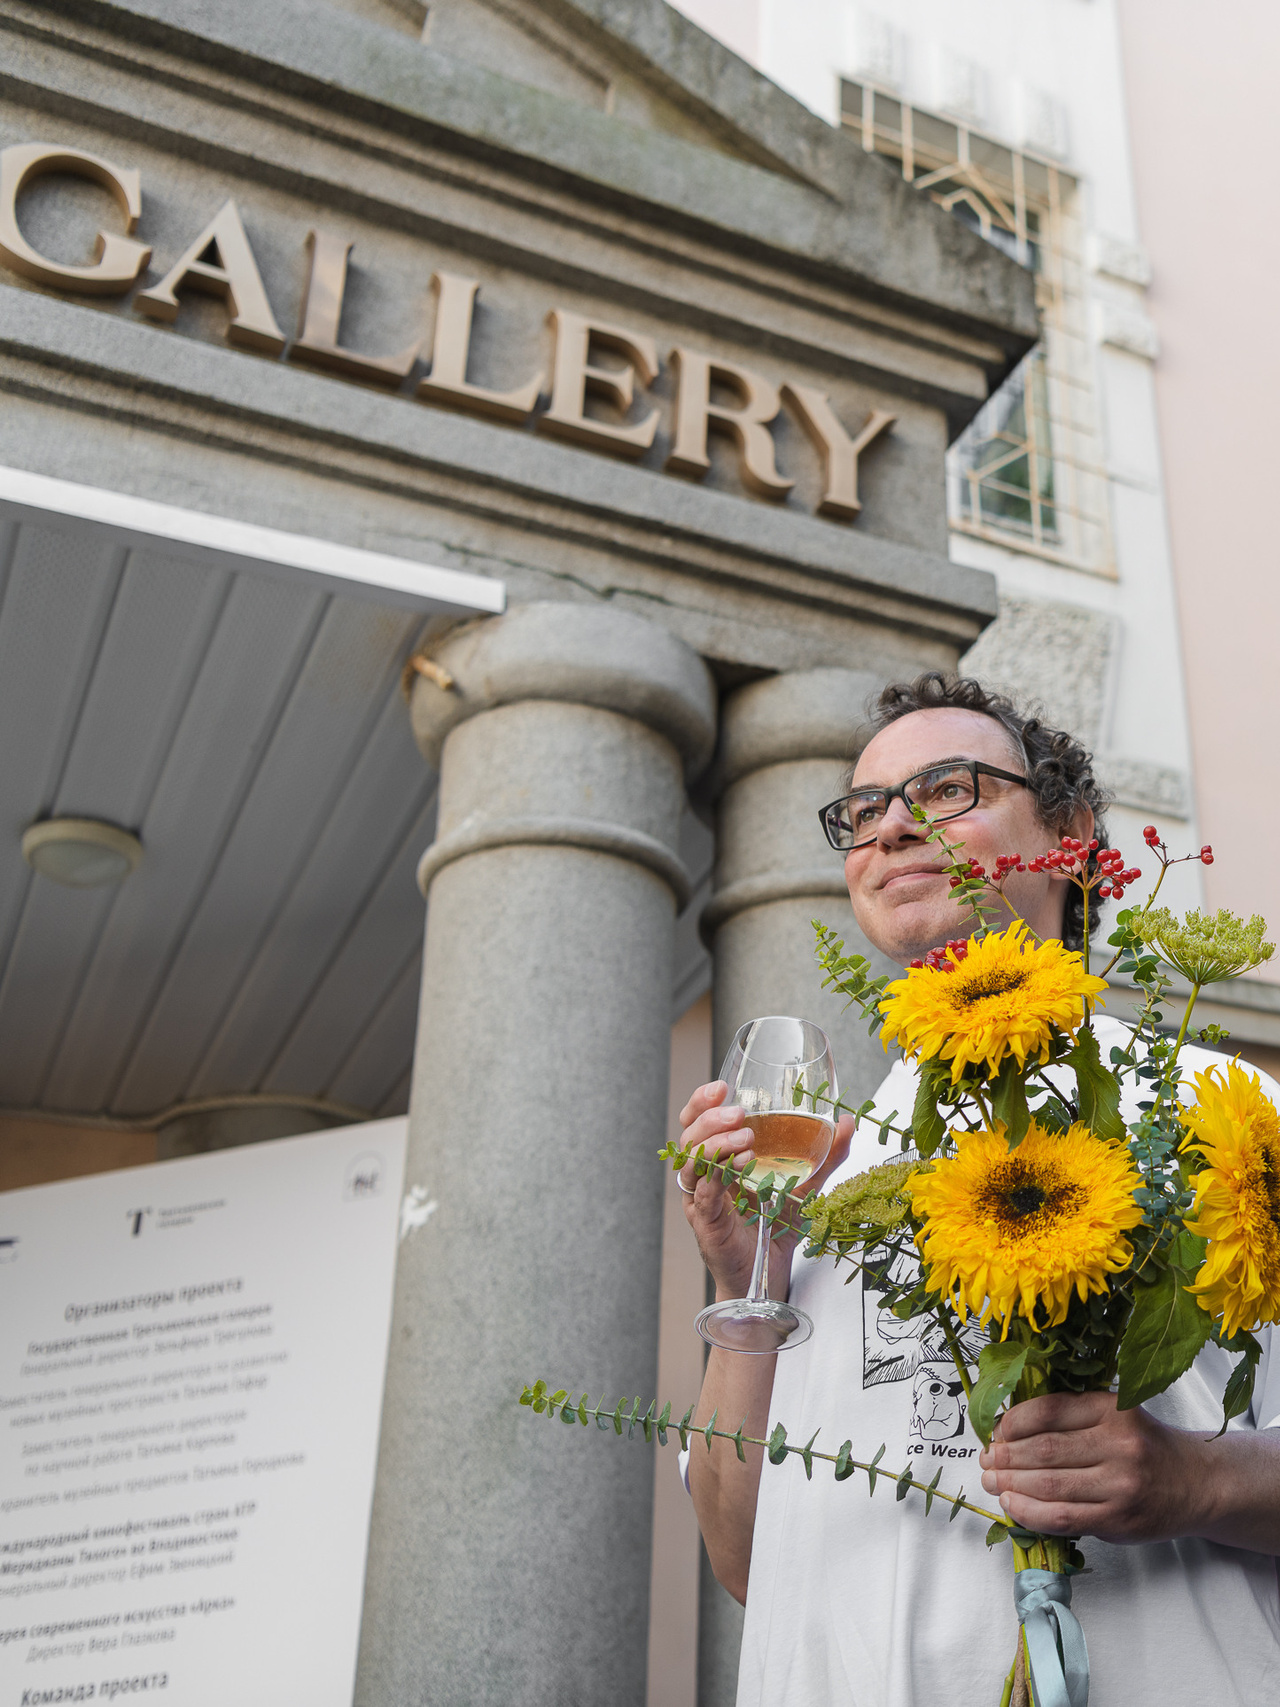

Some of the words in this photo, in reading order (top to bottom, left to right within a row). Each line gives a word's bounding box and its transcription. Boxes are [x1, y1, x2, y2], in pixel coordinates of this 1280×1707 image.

[0, 142, 897, 521] GALLERY
[931, 1443, 977, 1458] Wear
[20, 1682, 96, 1707] Команда
[99, 1671, 168, 1702] проекта
